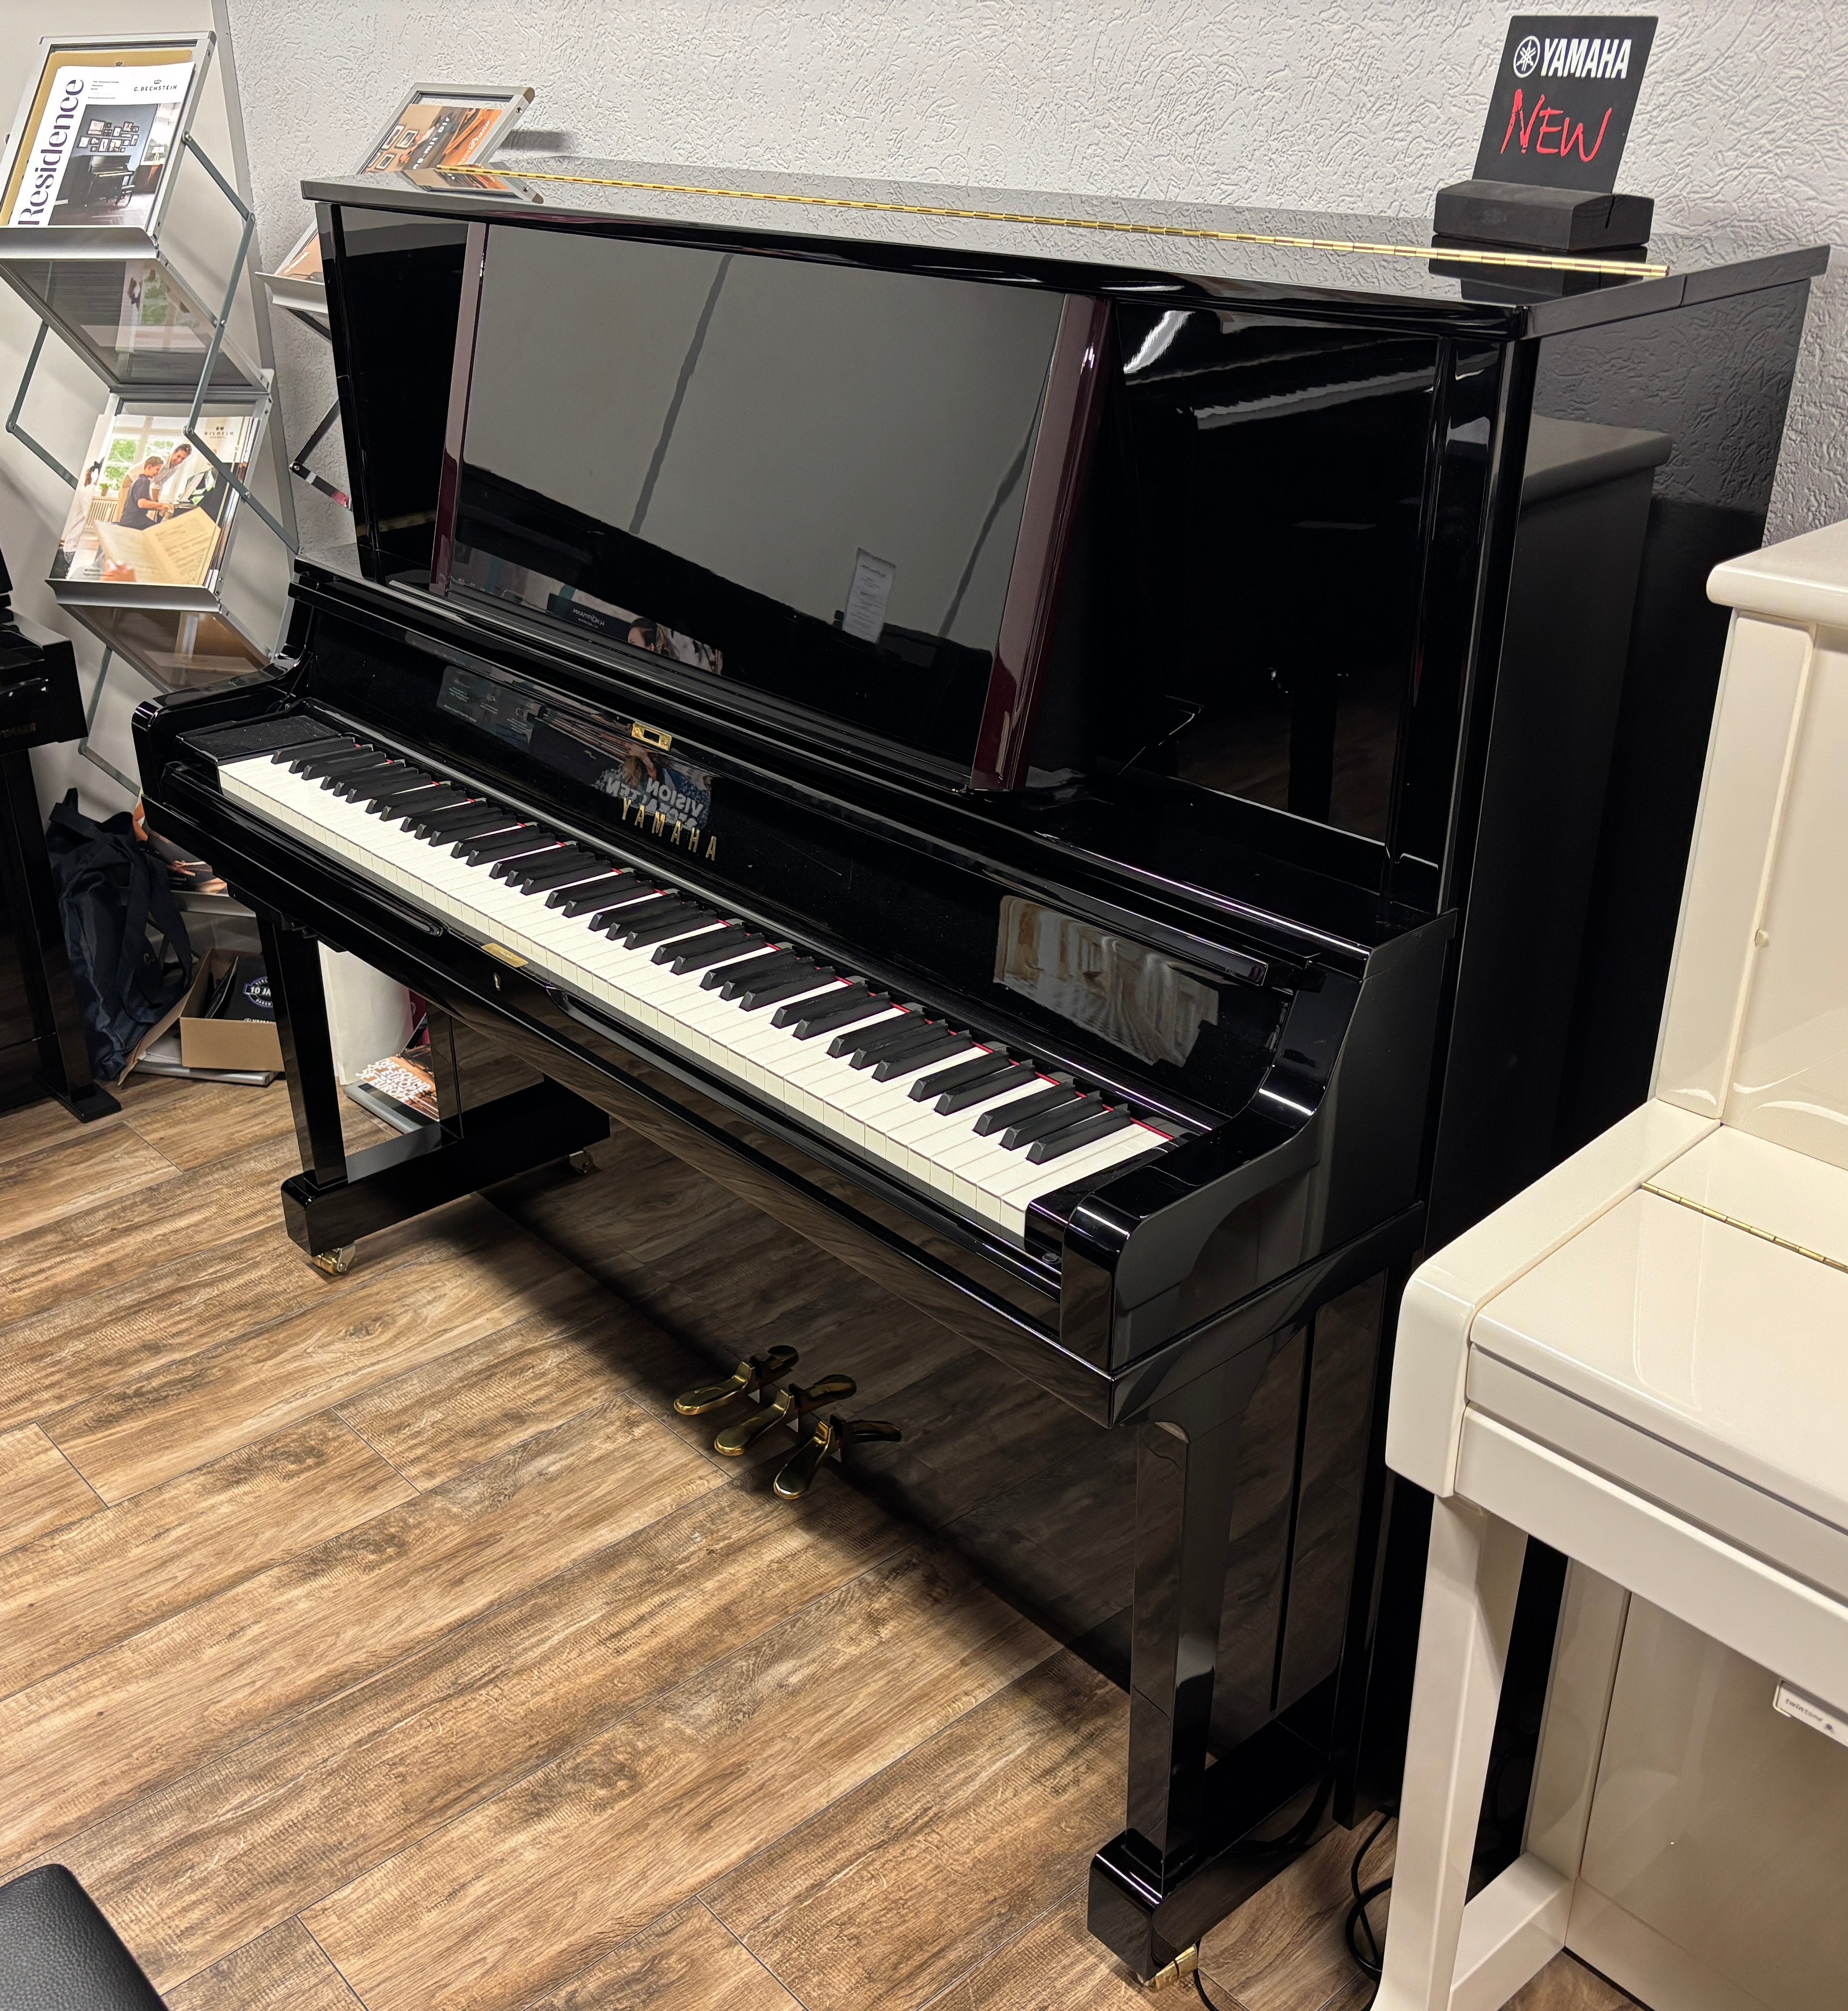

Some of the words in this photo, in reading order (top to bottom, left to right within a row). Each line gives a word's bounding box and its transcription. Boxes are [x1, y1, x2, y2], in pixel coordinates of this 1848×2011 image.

[1540, 38, 1632, 79] YAMAHA
[18, 79, 84, 225] Residence
[1500, 89, 1613, 163] NEW
[622, 796, 717, 861] YAMAHA
[250, 986, 261, 994] 10
[262, 987, 271, 997] JA
